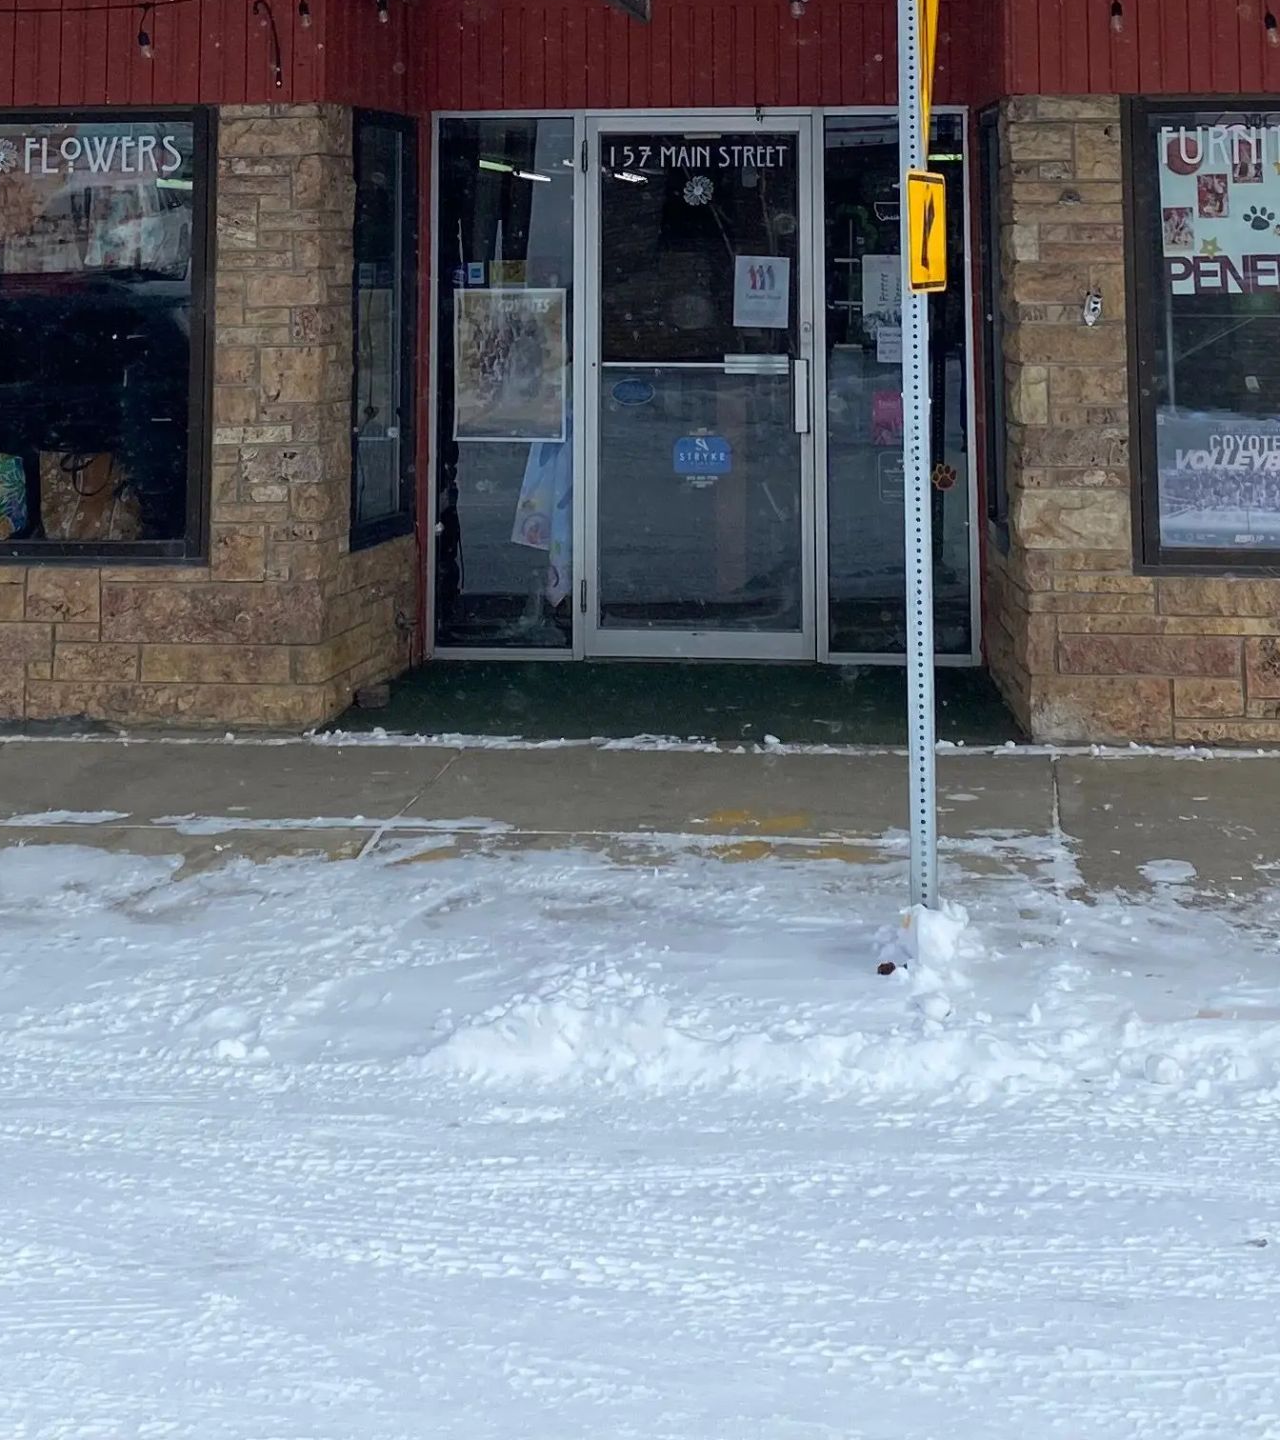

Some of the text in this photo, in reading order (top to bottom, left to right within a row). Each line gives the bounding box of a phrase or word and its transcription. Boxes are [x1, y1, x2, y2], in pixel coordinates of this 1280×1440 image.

[24, 135, 183, 174] FLOWERS
[660, 146, 710, 168] MAIN
[718, 145, 787, 167] STREET
